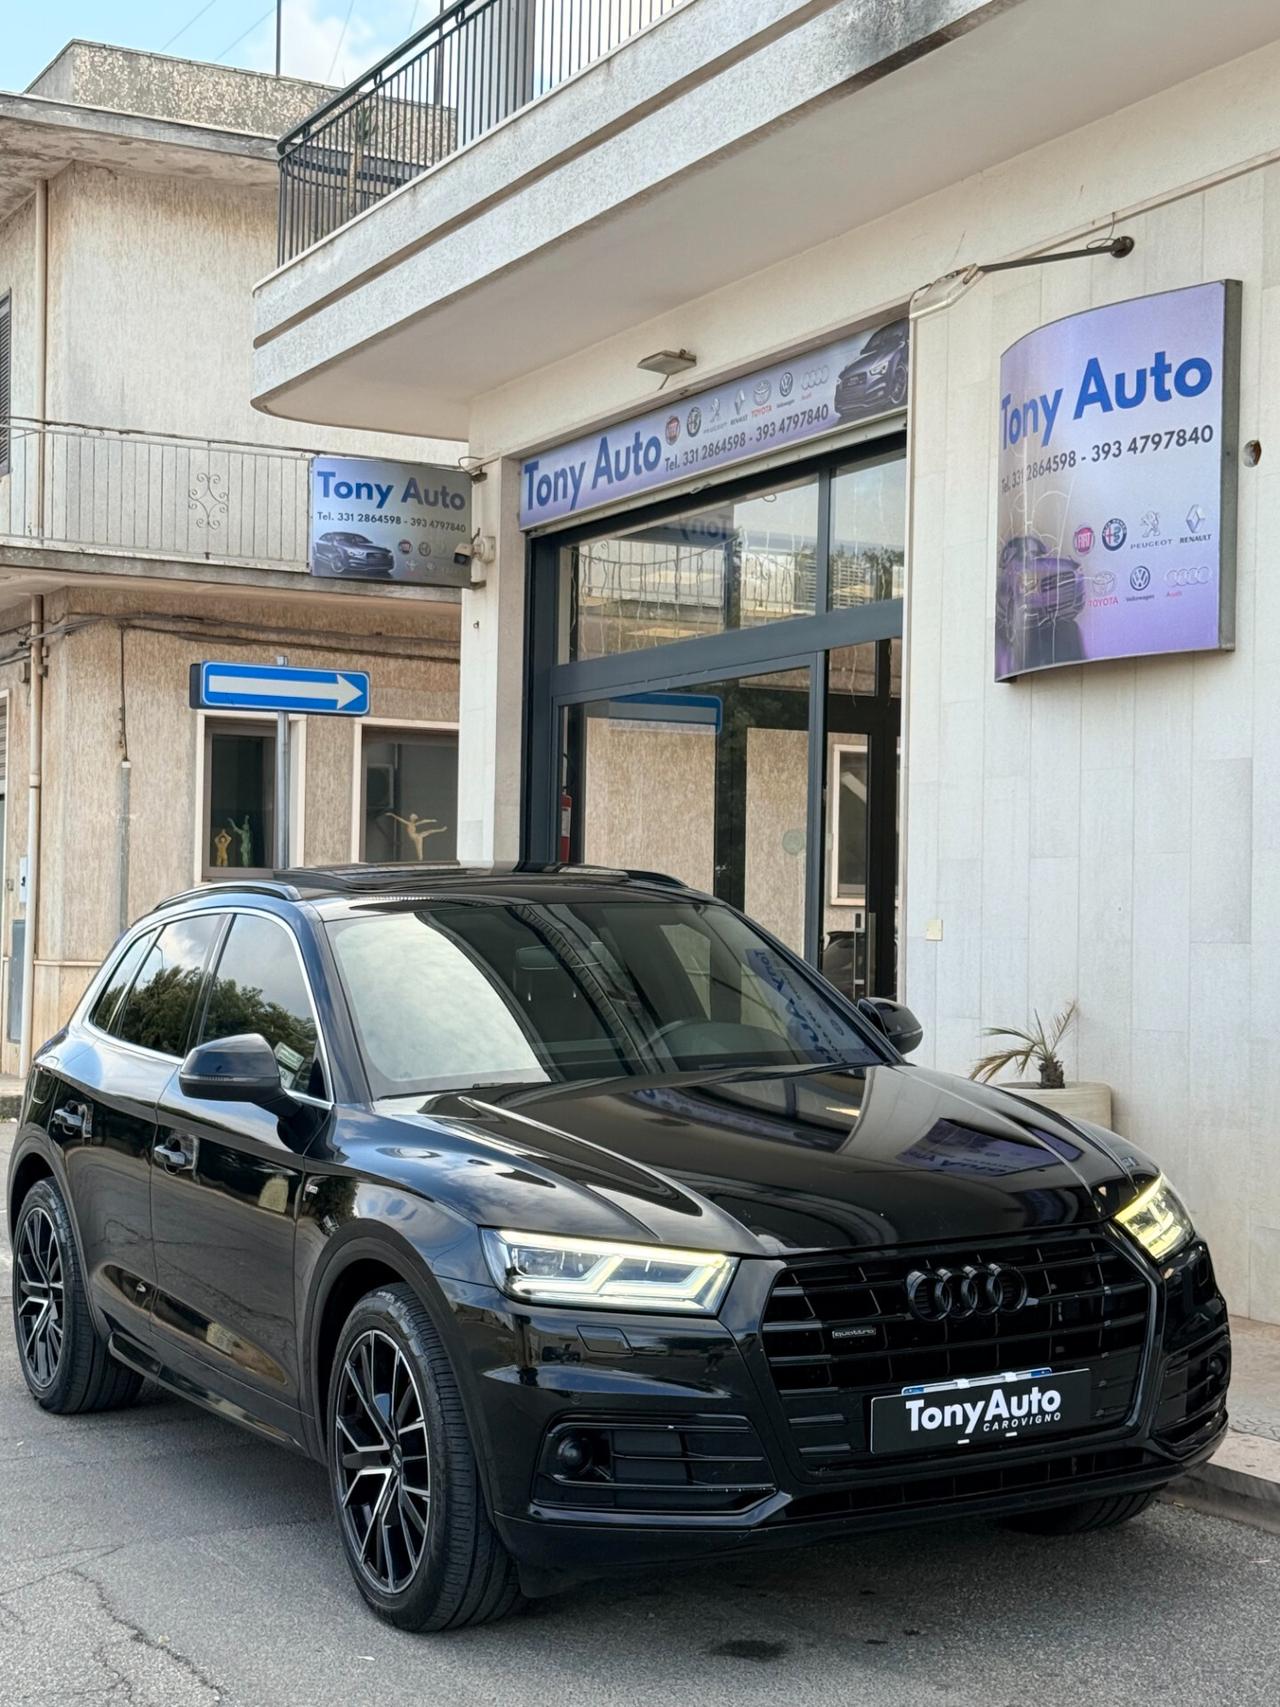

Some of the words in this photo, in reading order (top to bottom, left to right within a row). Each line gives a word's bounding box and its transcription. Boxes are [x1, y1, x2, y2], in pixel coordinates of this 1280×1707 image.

[1001, 388, 1063, 450] Tony
[1073, 351, 1212, 420] Auto
[664, 457, 681, 473] Tel.
[683, 447, 699, 466] 331
[702, 431, 746, 460] 2864598
[756, 422, 776, 443] 393
[778, 404, 829, 434] 4797840
[1026, 450, 1076, 482] 2864598
[1092, 440, 1122, 462] 393
[1127, 424, 1214, 455] 4797840
[317, 471, 394, 509] Tony
[401, 477, 466, 511] Auto
[524, 461, 586, 511] Tony
[592, 431, 662, 490] Auto
[317, 512, 334, 521] Tel.
[338, 512, 354, 522] 331
[358, 513, 401, 525] 2864598
[411, 517, 427, 528] 393
[429, 519, 466, 533] 4797840
[1130, 538, 1173, 550] PEUGEOT
[1179, 534, 1212, 545] RENAULT
[1087, 596, 1119, 608] TOYOTA
[983, 1412, 1061, 1432] CAROVIGNO
